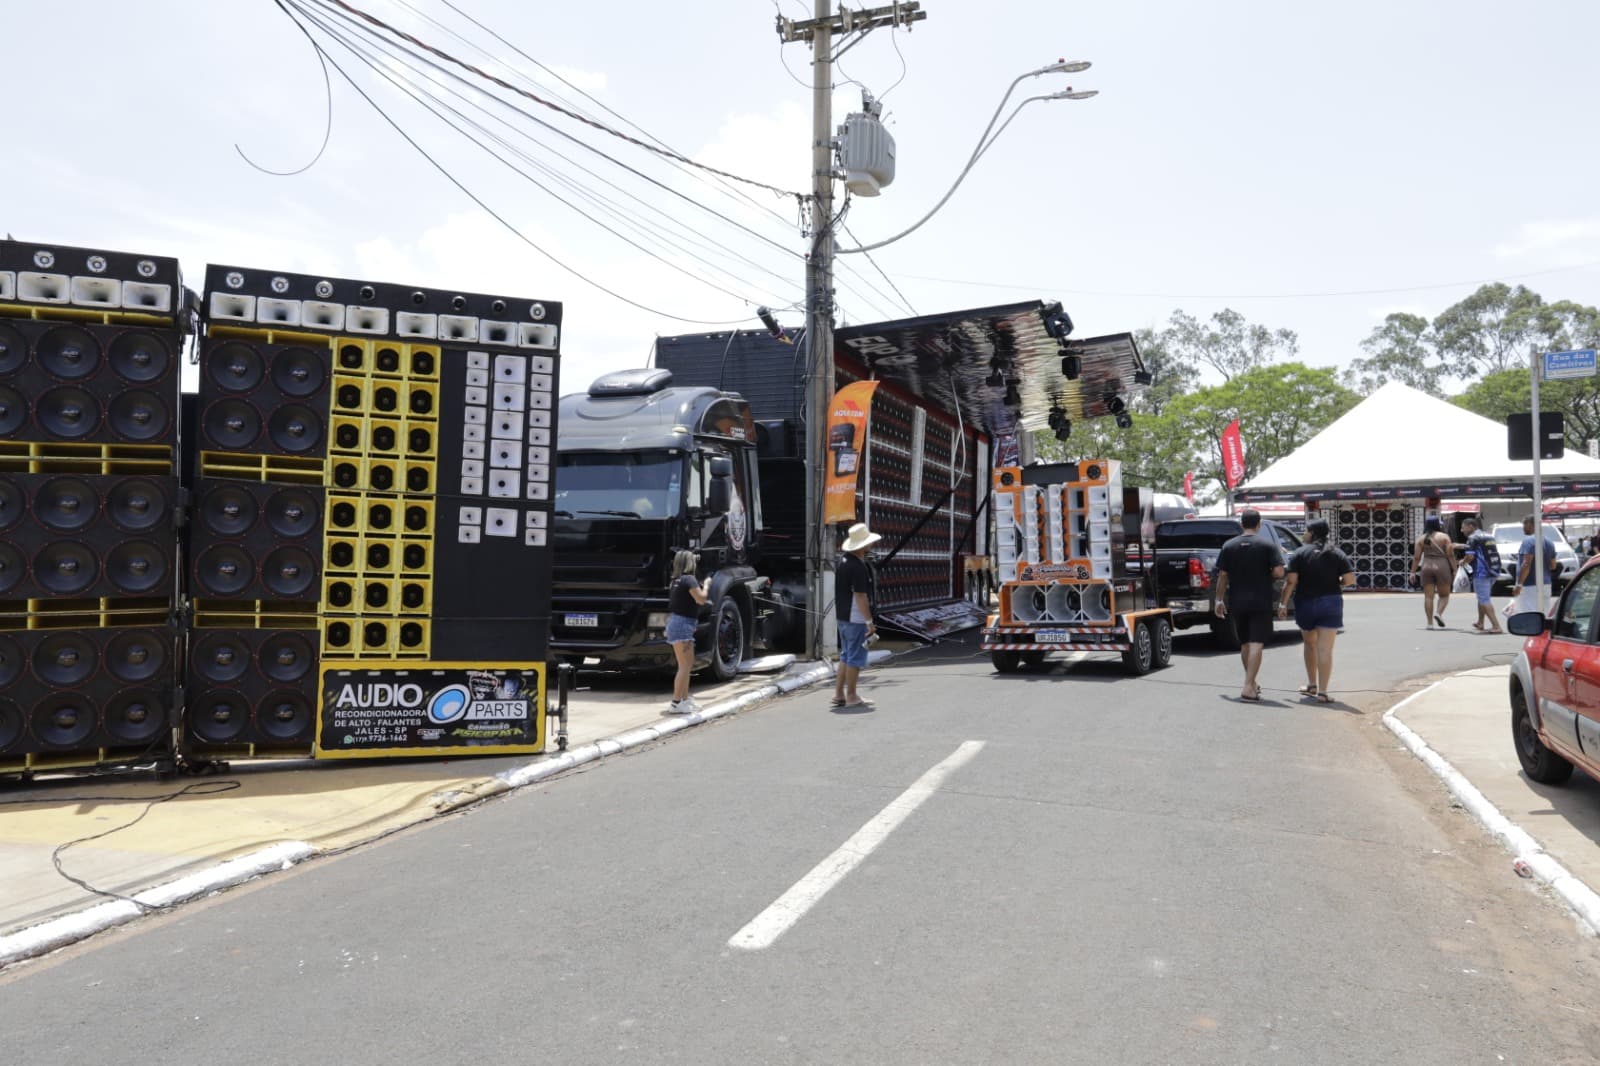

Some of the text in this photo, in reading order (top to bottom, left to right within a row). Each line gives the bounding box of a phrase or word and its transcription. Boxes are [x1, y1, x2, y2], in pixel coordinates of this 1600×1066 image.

[336, 683, 423, 708] AUDIO
[334, 709, 427, 719] RECONDICIONADORA
[475, 702, 523, 717] PARTS
[334, 719, 347, 727] DE
[348, 718, 371, 727] ALTO
[377, 718, 422, 726] FALANTES
[354, 727, 387, 735] JALES
[394, 726, 408, 734] SP
